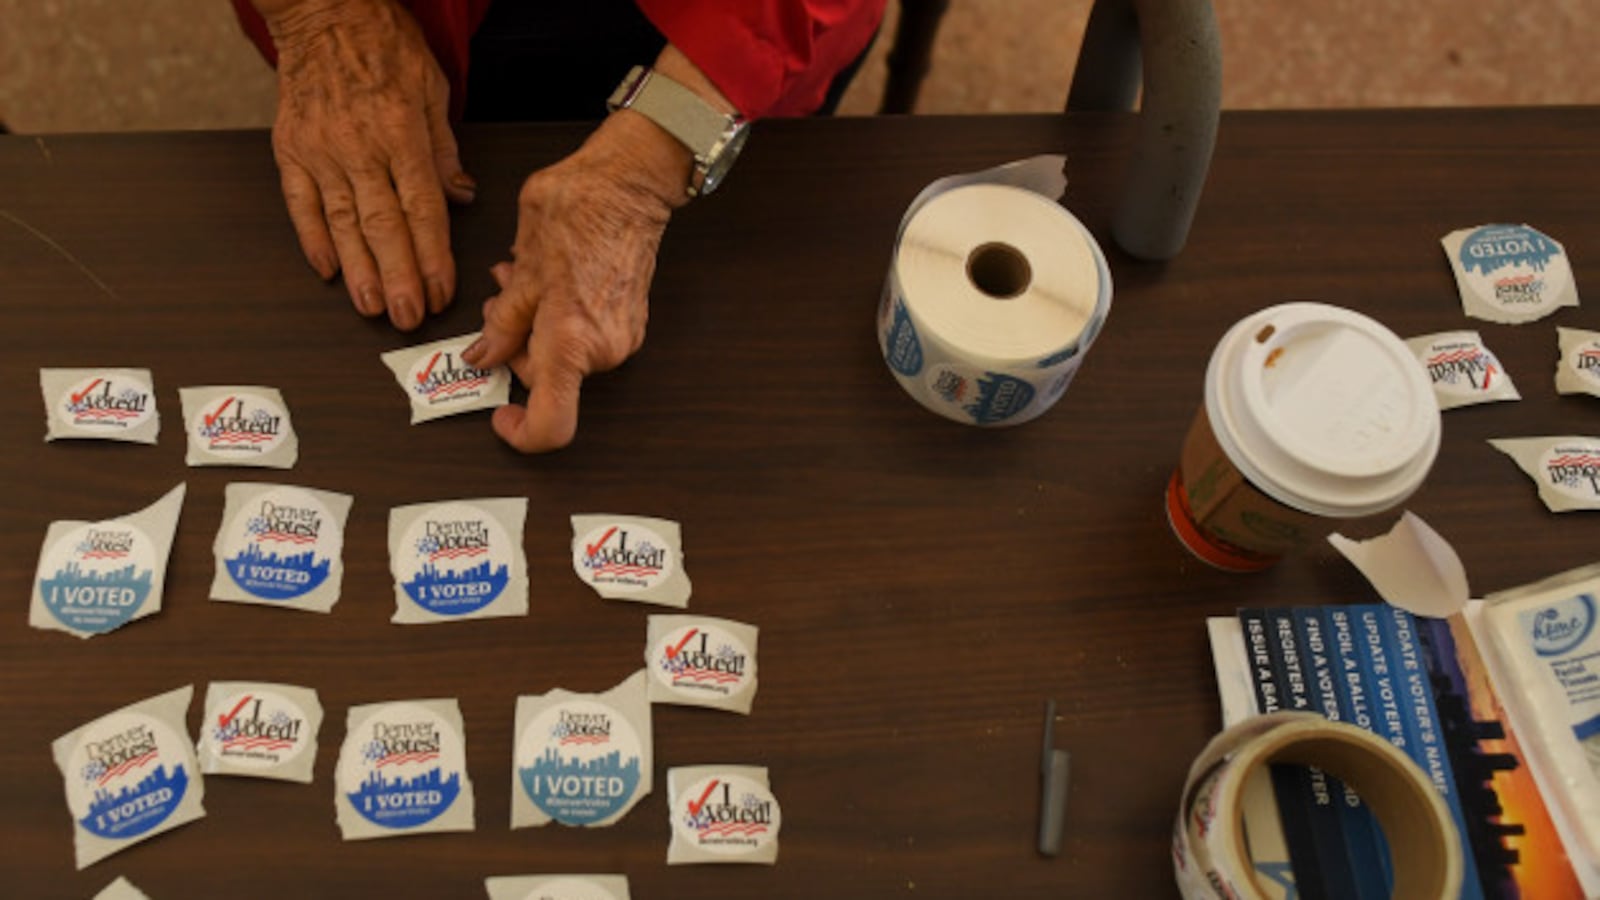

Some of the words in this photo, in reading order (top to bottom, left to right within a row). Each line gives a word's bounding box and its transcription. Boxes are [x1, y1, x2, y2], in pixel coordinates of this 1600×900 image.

[1470, 240, 1536, 258] VOTED
[1468, 369, 1478, 389] I
[103, 381, 111, 400] I
[235, 400, 244, 420] I
[261, 500, 319, 522] Denver
[425, 520, 483, 537] Denver
[620, 531, 628, 550] I
[236, 563, 246, 579] I
[250, 565, 311, 584] VOTED
[51, 586, 59, 604] I
[64, 586, 136, 606] VOTED
[418, 586, 426, 600] I
[431, 582, 491, 598] VOTED
[700, 633, 708, 653] I
[1248, 618, 1270, 665] ISSUE
[1305, 616, 1324, 652] FIND
[1332, 611, 1353, 655] SPOIL
[1362, 612, 1388, 675] UPDATE
[1276, 617, 1305, 695] REGISTER
[1293, 697, 1308, 709] A
[1313, 656, 1328, 668] A
[1342, 659, 1357, 670] A
[1258, 668, 1272, 680] A
[1317, 668, 1340, 722] VOTER
[1346, 673, 1374, 734] BALLO
[254, 699, 263, 721] I
[1407, 673, 1436, 745] VOTER'S
[373, 721, 435, 740] Denver
[532, 775, 541, 795] I
[546, 775, 625, 797] VOTED
[723, 783, 731, 806] I
[95, 815, 106, 830] I
[108, 787, 174, 822] VOTED
[364, 795, 372, 811] I
[376, 790, 442, 808] VOTED
